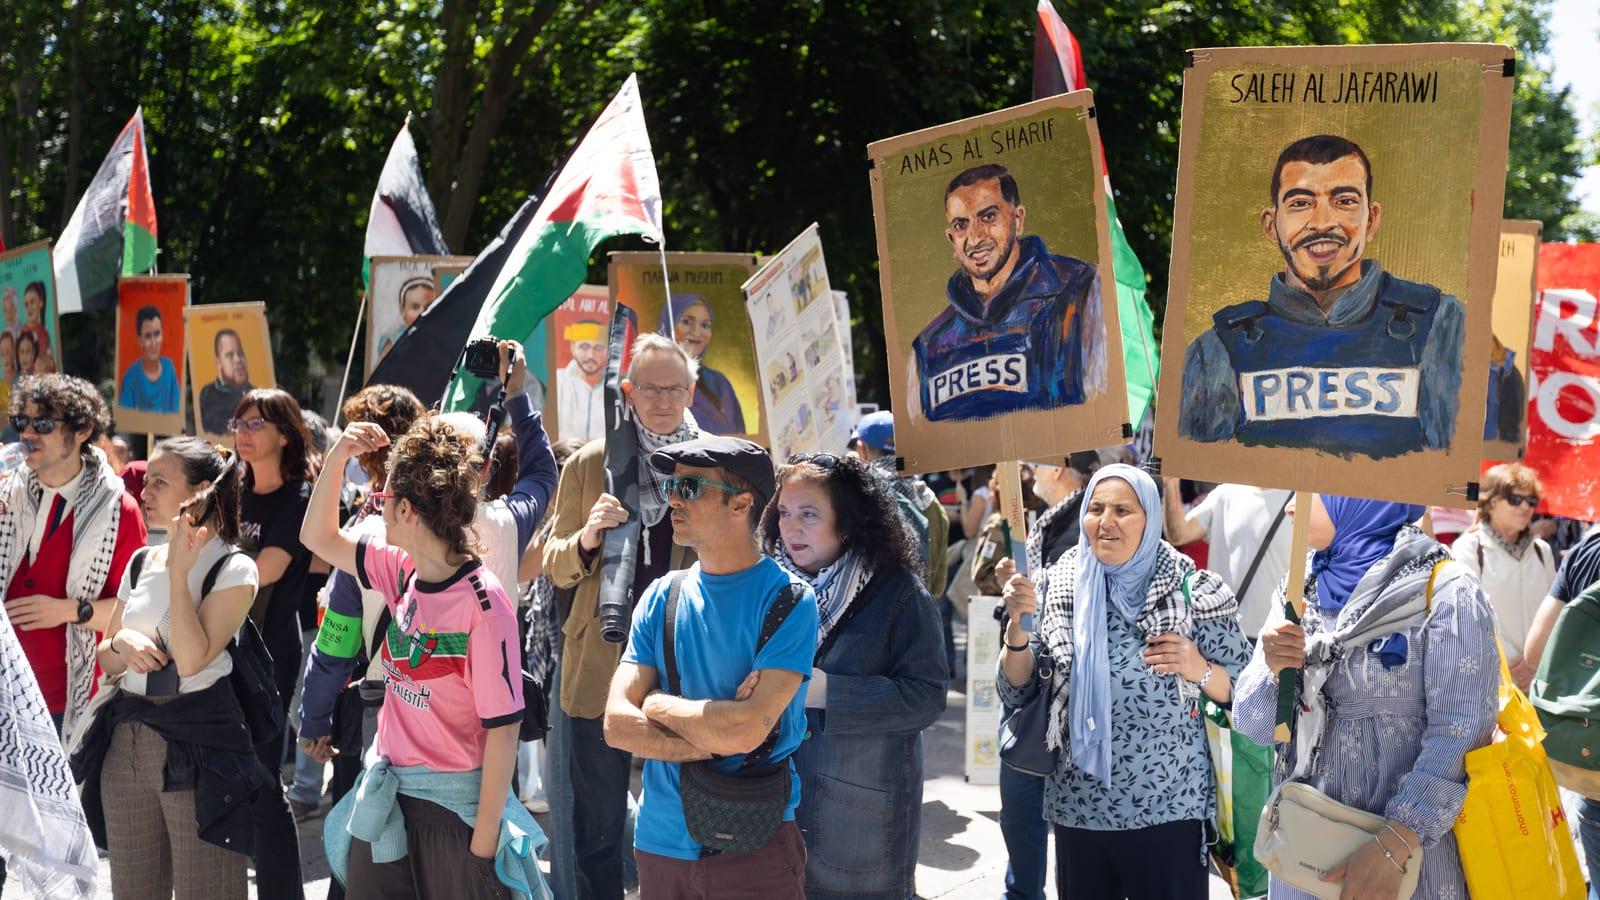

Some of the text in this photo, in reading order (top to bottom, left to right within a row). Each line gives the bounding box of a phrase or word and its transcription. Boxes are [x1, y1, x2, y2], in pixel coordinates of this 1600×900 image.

[1229, 70, 1439, 105] SALEH AL JAFARAWI
[900, 118, 1057, 176] ANAS AL SHARIF
[1501, 240, 1516, 257] EH
[684, 271, 723, 285] MUSLIM
[933, 356, 1023, 404] PRESS
[1252, 370, 1406, 416] PRESS
[324, 616, 349, 632] ENSA
